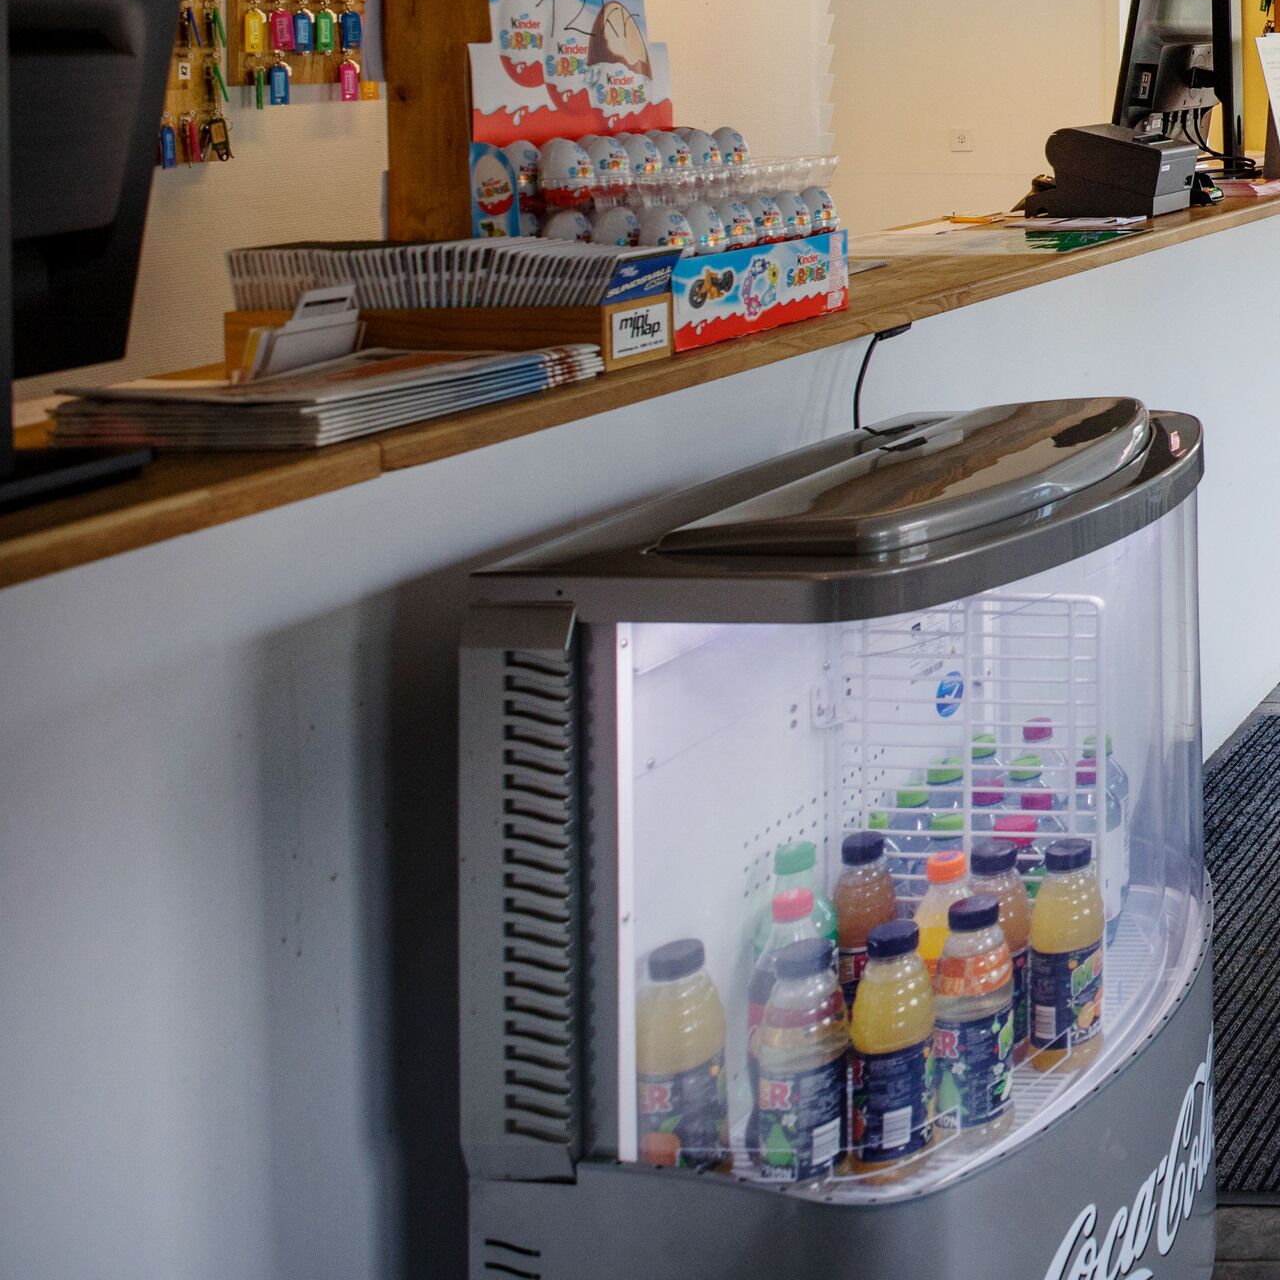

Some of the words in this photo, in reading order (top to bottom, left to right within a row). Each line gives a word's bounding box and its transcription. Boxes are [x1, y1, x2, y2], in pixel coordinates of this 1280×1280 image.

[510, 16, 541, 30] Kinder
[557, 41, 589, 55] Kinder
[606, 72, 634, 86] Kinder
[796, 253, 820, 267] Kinder
